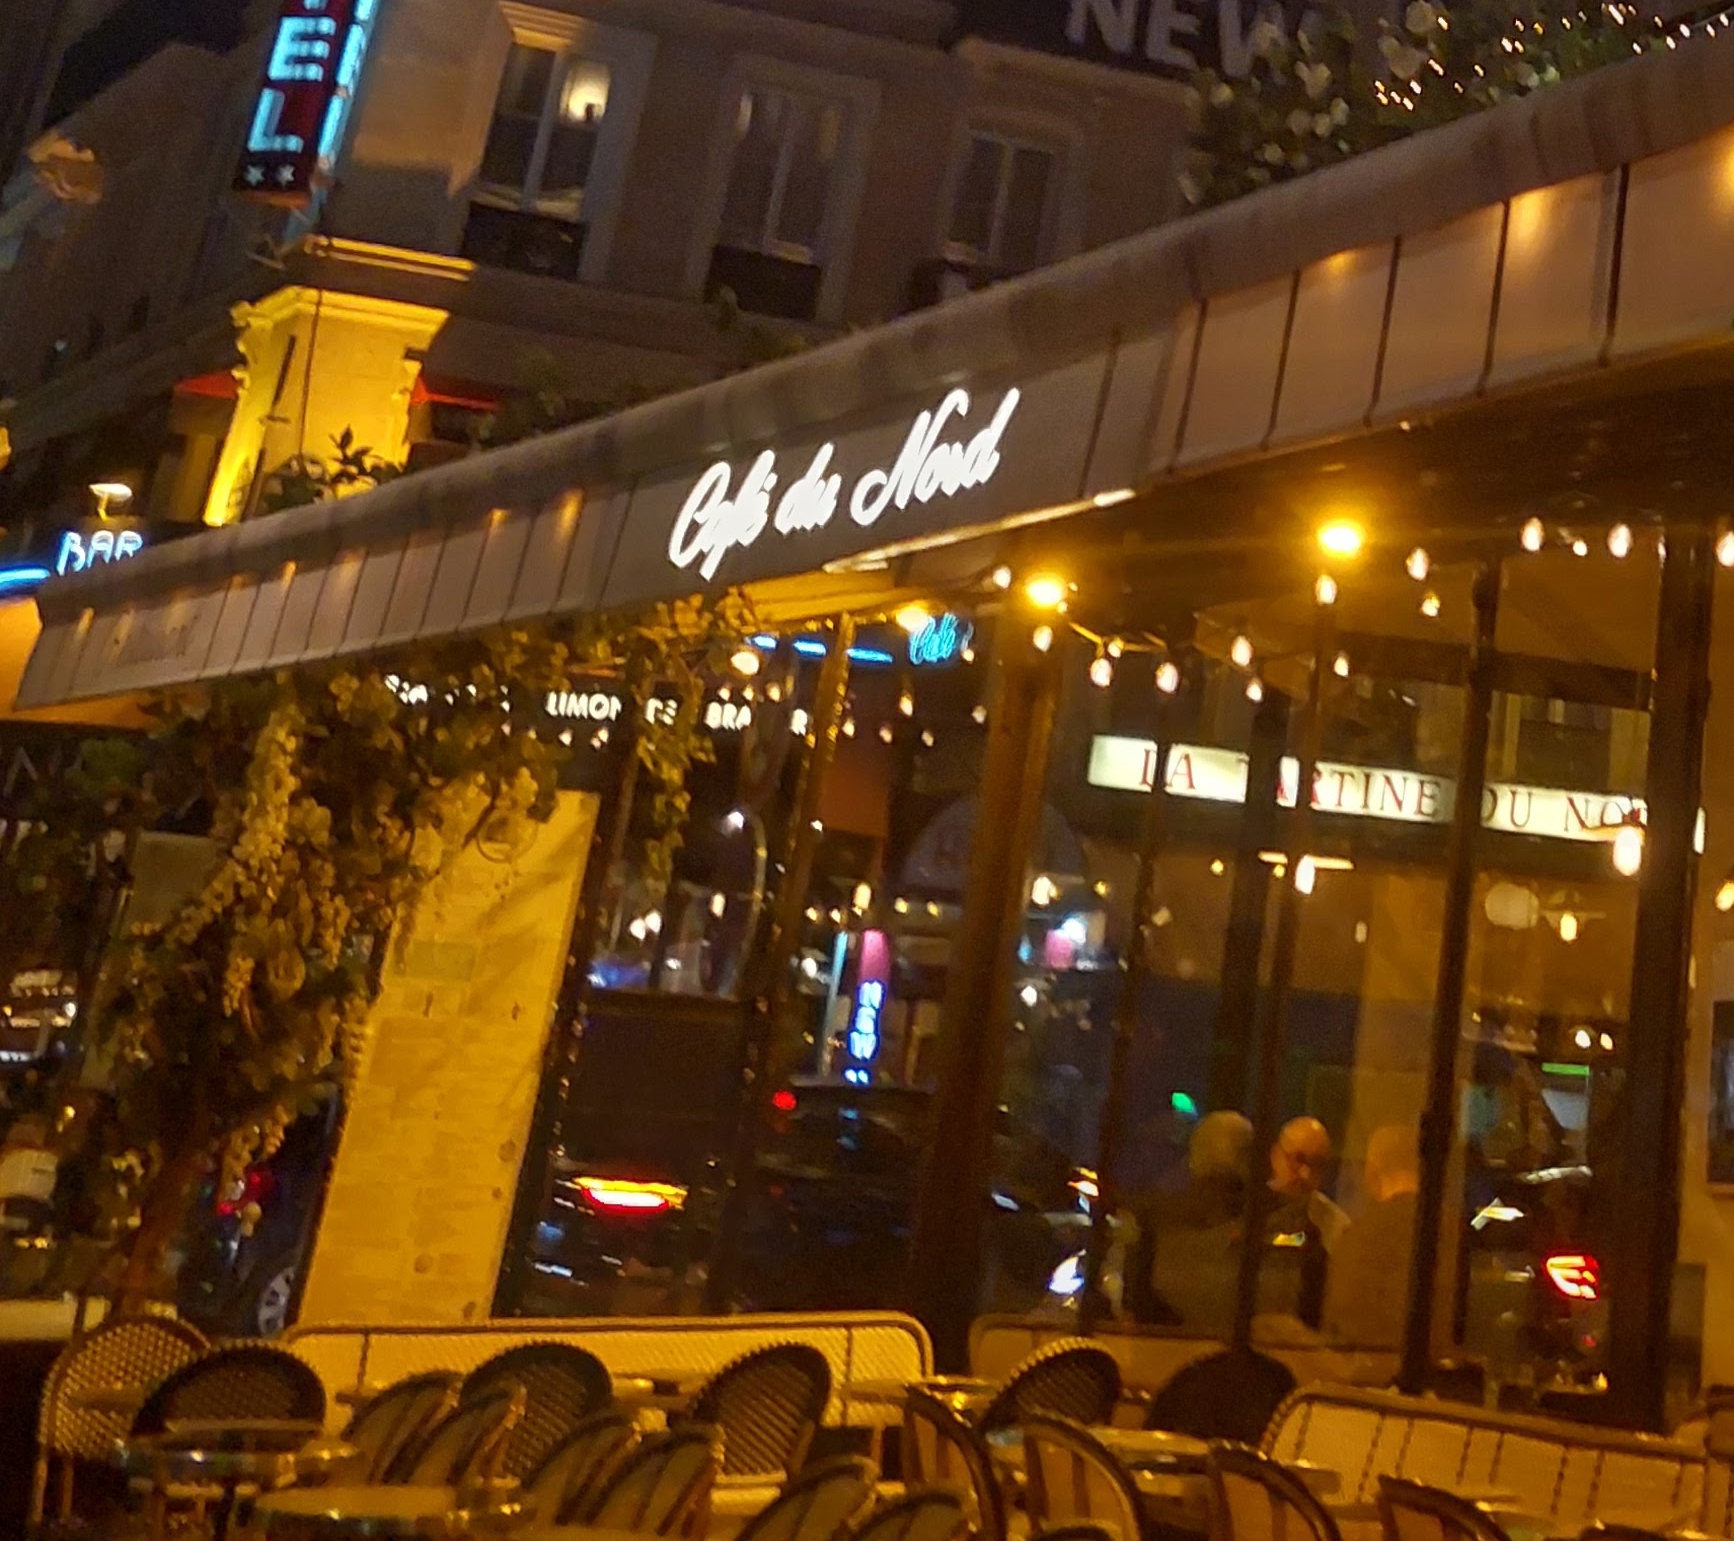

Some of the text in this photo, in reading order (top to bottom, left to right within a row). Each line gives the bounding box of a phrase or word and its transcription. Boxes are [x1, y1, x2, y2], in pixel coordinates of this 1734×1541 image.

[774, 441, 842, 535] du
[849, 387, 1021, 527] Nord
[56, 529, 144, 577] BAR
